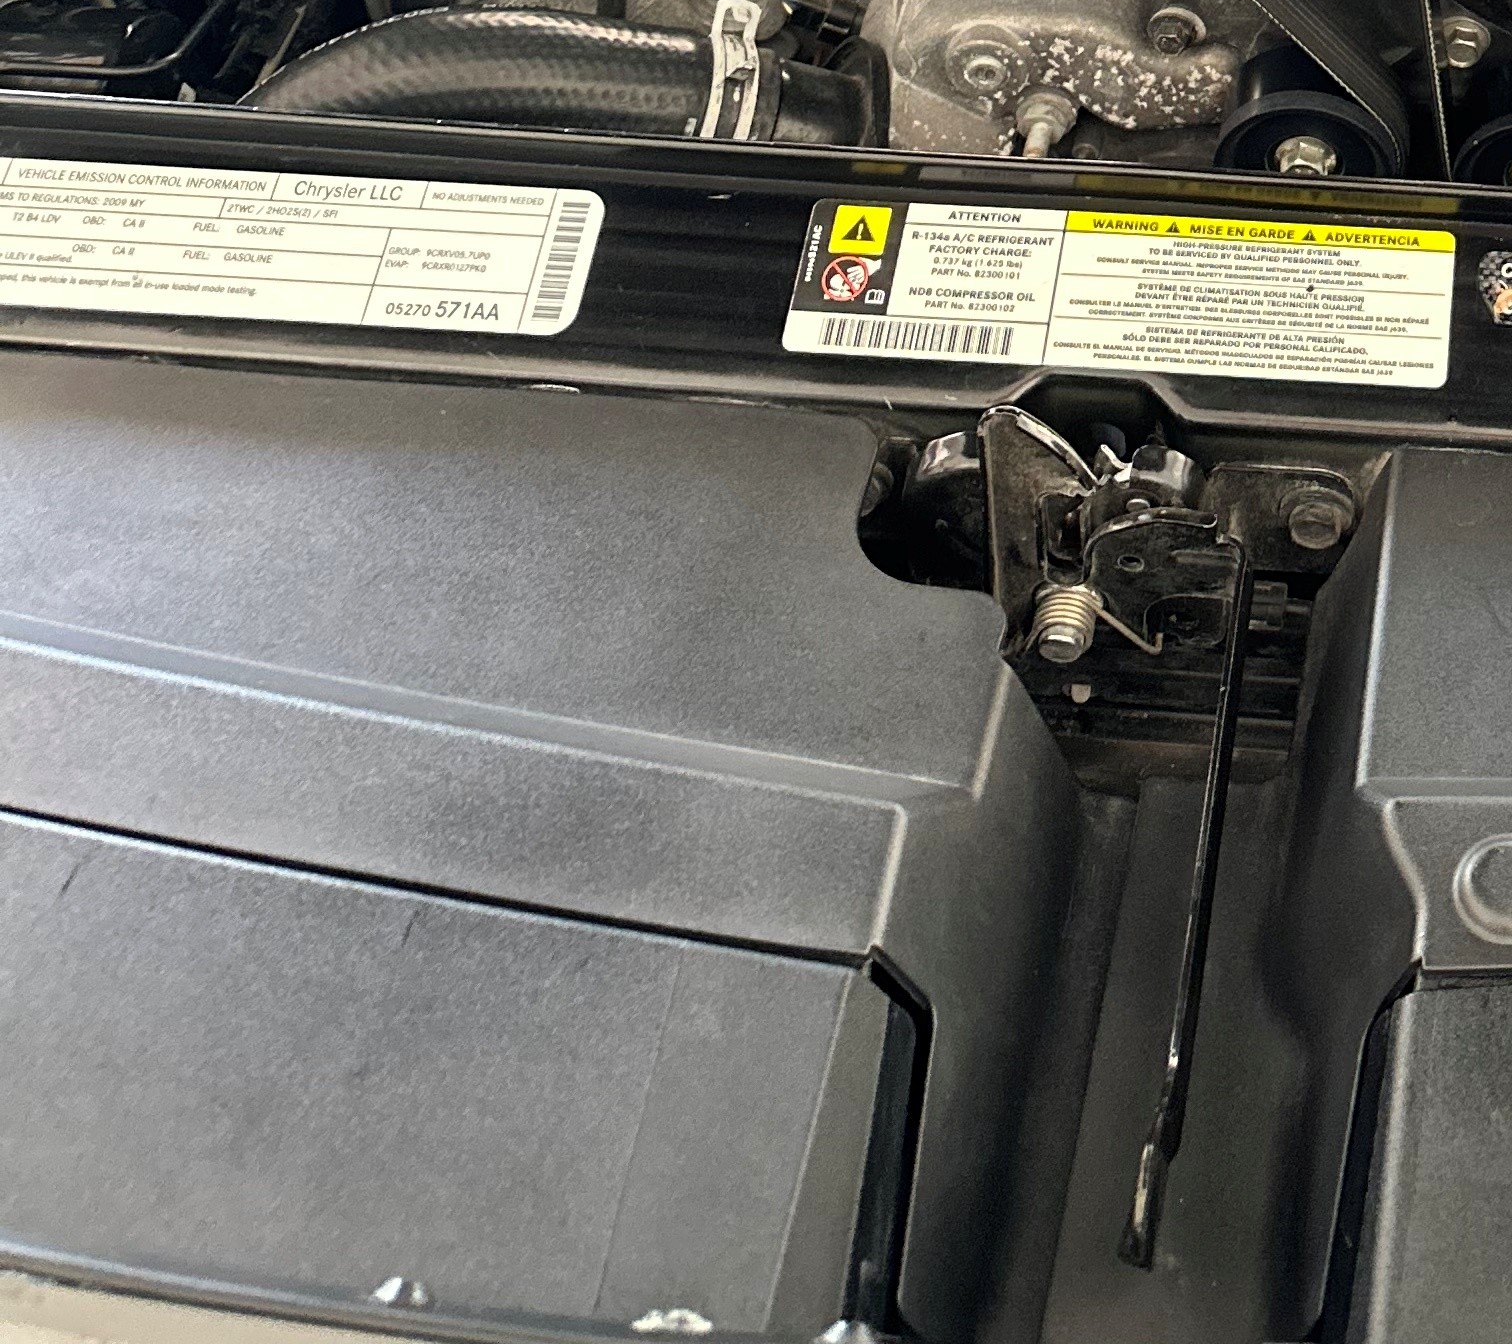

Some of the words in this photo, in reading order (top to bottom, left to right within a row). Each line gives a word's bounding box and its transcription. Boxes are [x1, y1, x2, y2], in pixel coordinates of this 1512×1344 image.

[16, 167, 67, 180] VEHICLE
[67, 170, 126, 184] EMISSION
[126, 173, 184, 187] CONTROL
[185, 176, 267, 191] INFORMATION
[291, 180, 368, 202] Chrysler
[368, 184, 404, 201] LLC
[16, 192, 30, 201] TO
[102, 197, 128, 206] 2009
[128, 198, 145, 207] MY
[431, 192, 445, 200] NO
[446, 192, 508, 203] ADJUSTMENTS
[509, 196, 545, 206] NEEDED
[226, 203, 255, 214] 2TWC
[256, 205, 264, 214] /
[312, 208, 321, 218] /
[321, 208, 338, 218] SFI
[948, 210, 1021, 223] ATTENTION
[235, 224, 285, 236] GASOLINE
[1091, 218, 1159, 232] WARNING
[1189, 223, 1223, 236] MISE
[1226, 225, 1245, 237] EN
[1248, 226, 1295, 239] GARDE
[1325, 231, 1420, 246] ADVERTENCIA
[911, 230, 951, 241] R-134a
[952, 232, 975, 244] A/C
[977, 234, 1054, 246] REFRIGERANT
[223, 252, 273, 263] GASOLINE
[928, 244, 980, 255] FACTORY
[982, 247, 1032, 257] CHARGE:
[1148, 248, 1160, 256] TO
[1162, 248, 1173, 256] BE
[1175, 249, 1218, 259] SERVICED
[1220, 252, 1231, 260] BY
[1233, 252, 1280, 262] QUALIFIED
[1282, 255, 1334, 265] PERSONNEL
[1245, 245, 1304, 255] REFRIGERANT
[1306, 248, 1340, 257] SYSTEM
[930, 267, 954, 276] PART
[956, 269, 972, 277] No.
[934, 287, 1014, 300] COMPRESSOR
[1015, 292, 1036, 301] OIL
[1134, 290, 1169, 300] DEVANT
[1172, 292, 1193, 302] ÊTRE
[1231, 296, 1248, 305] PAR
[1250, 297, 1264, 305] UN
[1266, 298, 1319, 309] TECHNICIEN
[1179, 284, 1191, 293] DE
[1193, 285, 1261, 297] CLIMATISATION
[1262, 289, 1287, 298] SOUS
[1289, 290, 1318, 300] HAUTE
[1320, 292, 1364, 302] PRESSION
[383, 302, 432, 317] 05270
[433, 300, 502, 320] 571AA
[924, 300, 947, 308] PART
[950, 301, 966, 309] No.
[1122, 333, 1146, 342] SÓLO
[1173, 336, 1190, 345] SER
[1192, 337, 1240, 347] REPARADO
[1242, 339, 1261, 349] POR
[1263, 341, 1310, 351] PERSONAL
[1145, 326, 1184, 335] SISTEMA
[1186, 328, 1198, 336] DE
[1200, 329, 1266, 339] REFRIGERANTE
[1282, 333, 1304, 342] ALTA
[1305, 335, 1345, 344] PRESIÓN
